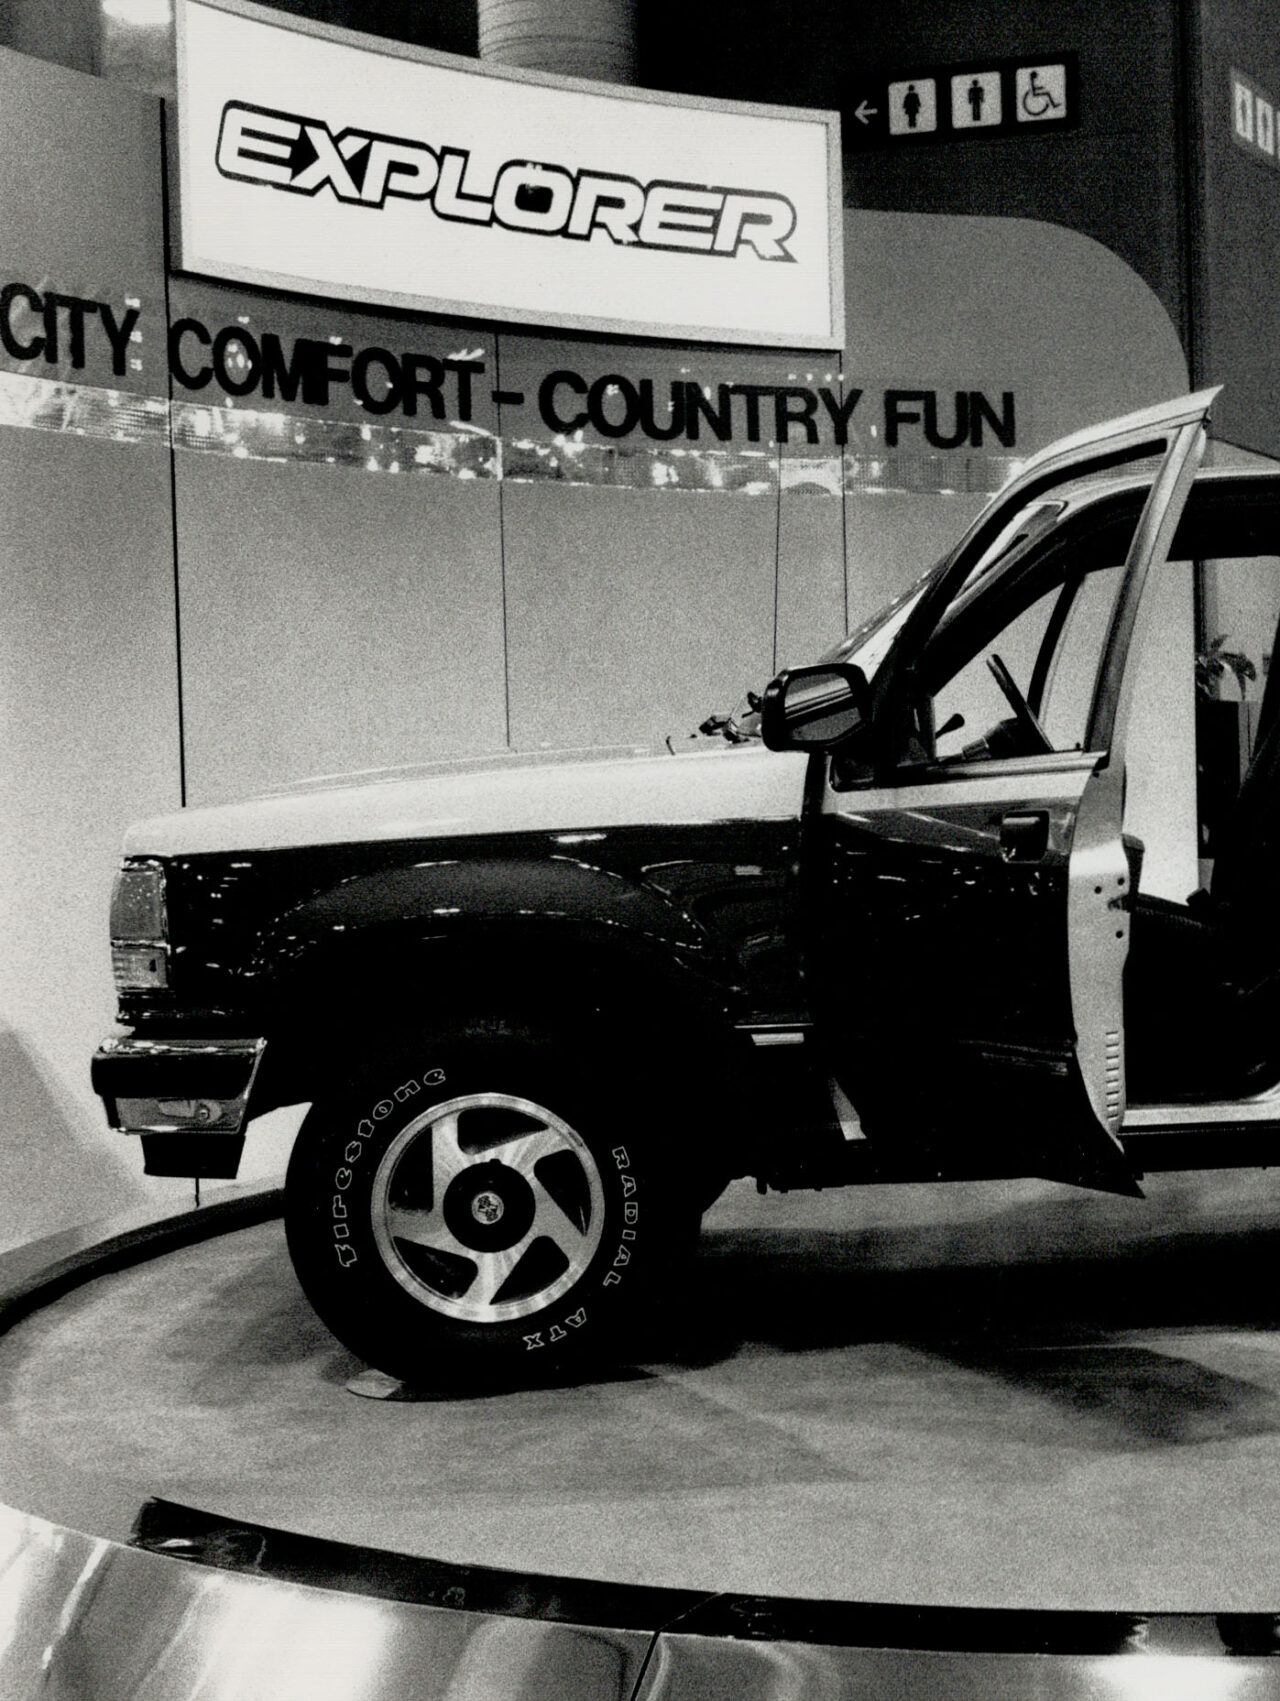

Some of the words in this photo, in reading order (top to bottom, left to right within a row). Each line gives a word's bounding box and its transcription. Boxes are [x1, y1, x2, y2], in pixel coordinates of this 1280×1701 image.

[215, 99, 797, 263] EXPLORER
[0, 283, 140, 376] CITY
[170, 319, 486, 422] COMFORT
[538, 370, 863, 446] COUNTRY
[884, 391, 1016, 449] FUN
[332, 1068, 446, 1267] Firestone
[602, 1146, 638, 1286] RADIAL
[522, 1307, 587, 1350] ATX
